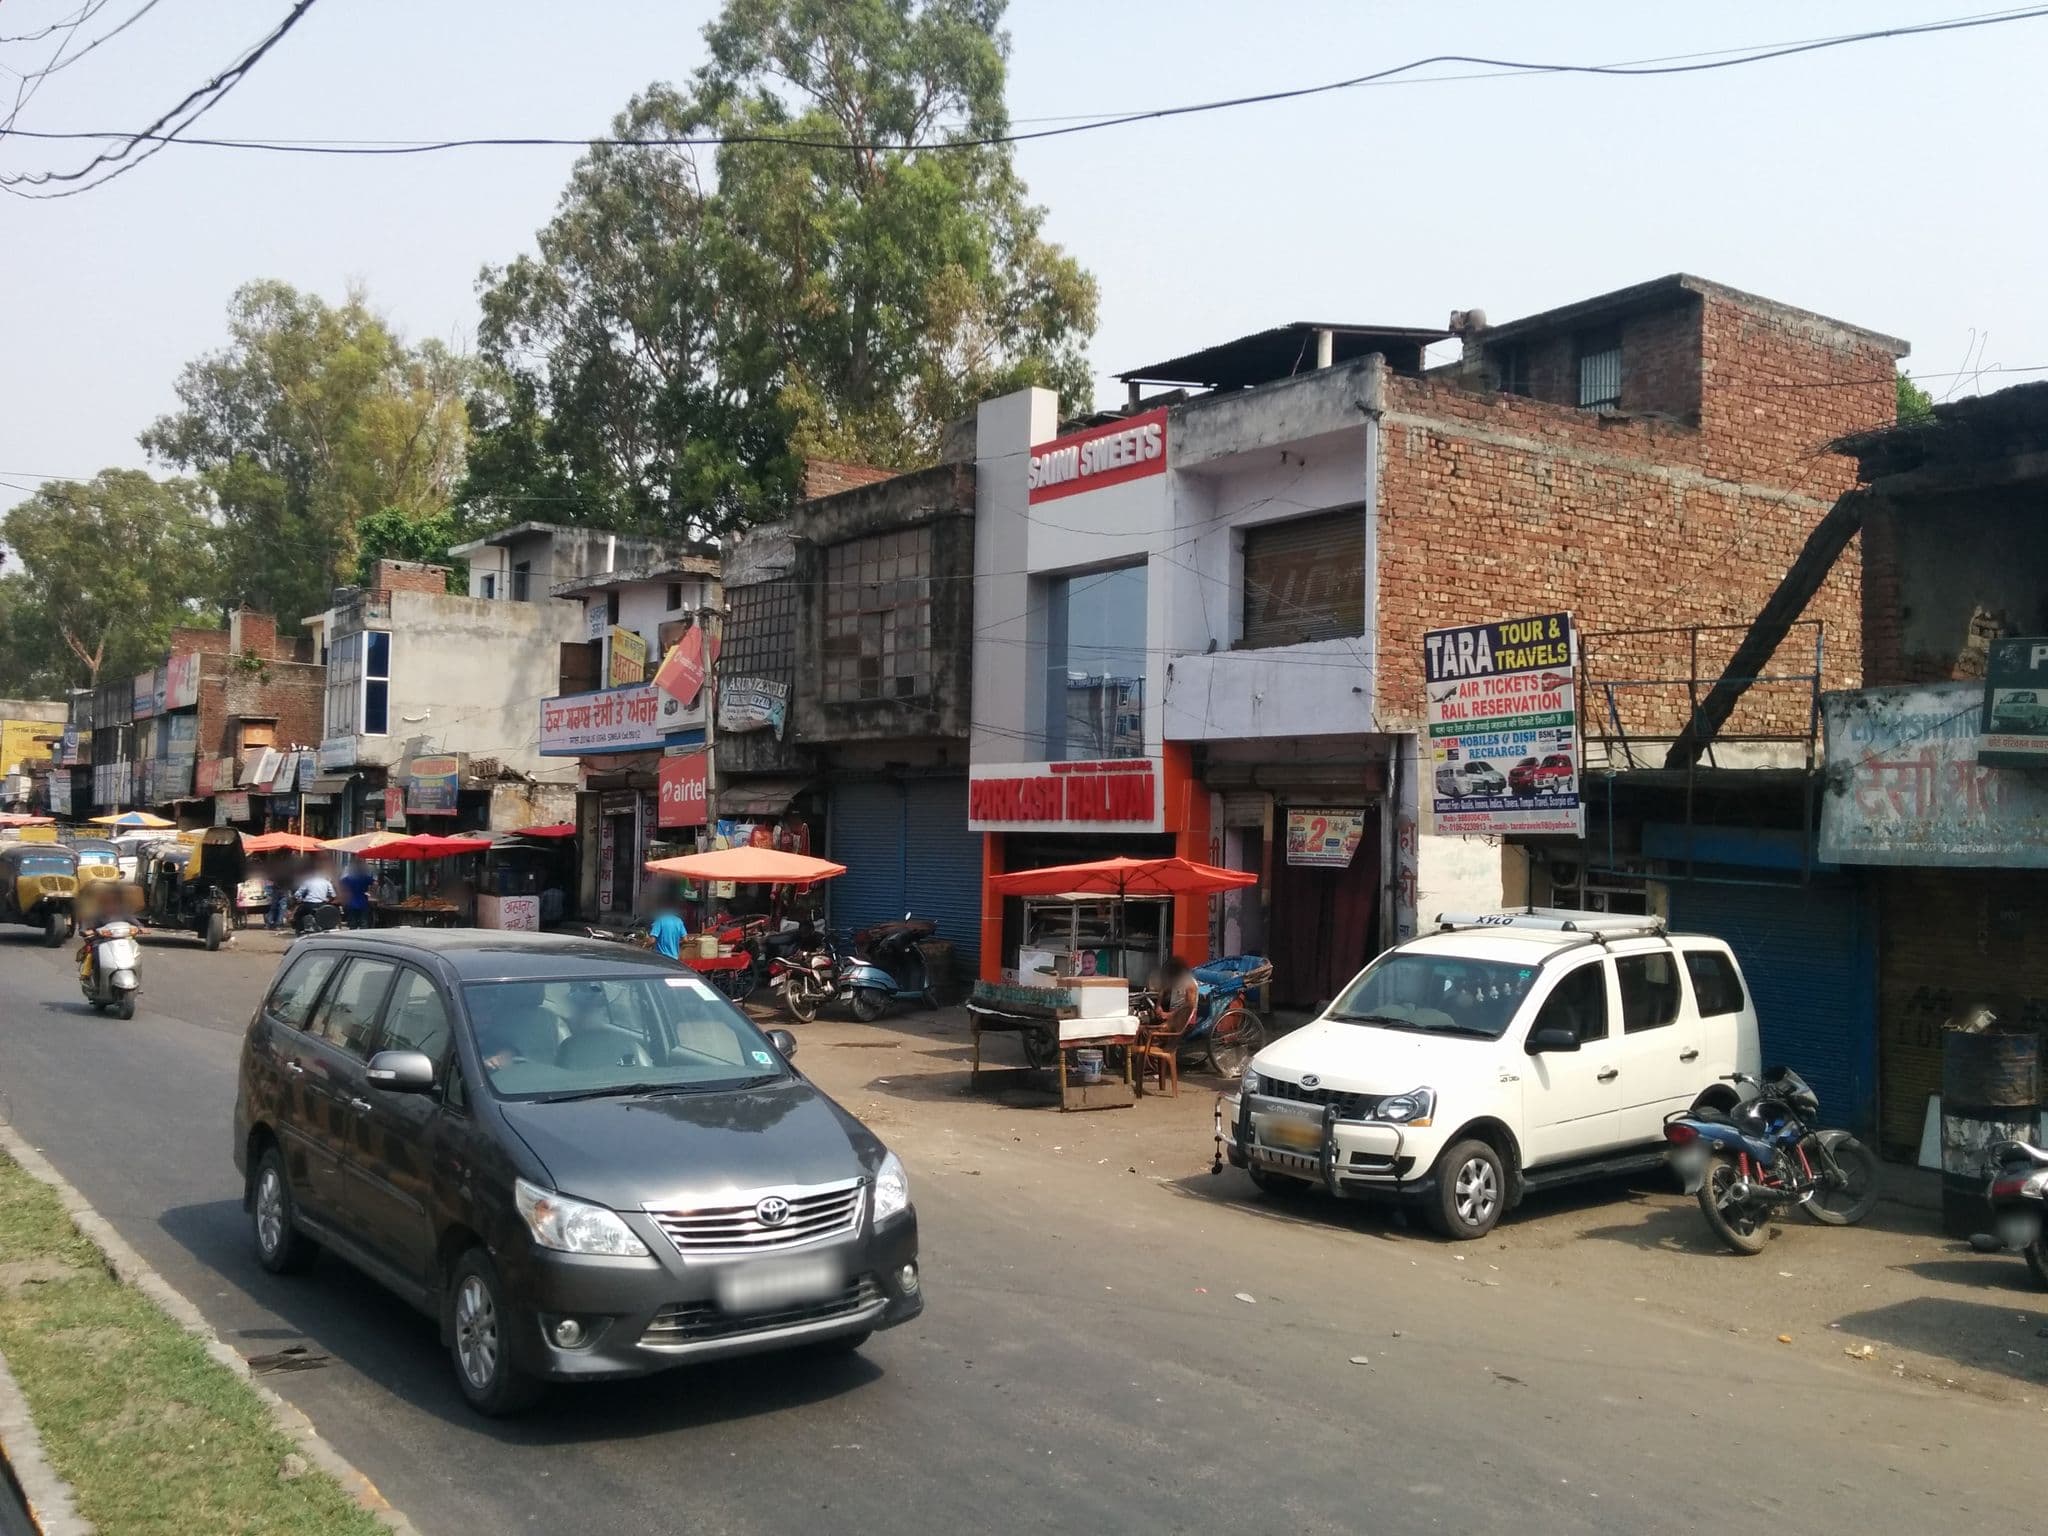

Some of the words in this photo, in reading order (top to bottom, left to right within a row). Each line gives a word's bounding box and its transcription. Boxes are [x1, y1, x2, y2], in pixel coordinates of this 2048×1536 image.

[1080, 423, 1162, 476] SWEETS
[1426, 629, 1494, 679] TARA
[1499, 620, 1544, 646] TOUR
[1548, 617, 1561, 639] &
[1495, 642, 1568, 671] TRAVELS
[1459, 681, 1479, 699] AIR
[1483, 674, 1539, 696] TICKETS
[1441, 702, 1468, 721] RAIL
[1472, 692, 1562, 718] RESERVATION
[1459, 735, 1499, 748] MOBILES
[1512, 730, 1537, 743] DISH
[1468, 745, 1528, 760] RECHARGES
[674, 776, 707, 802] airtel
[1305, 816, 1328, 853] 2
[1475, 915, 1514, 926] XYLO
